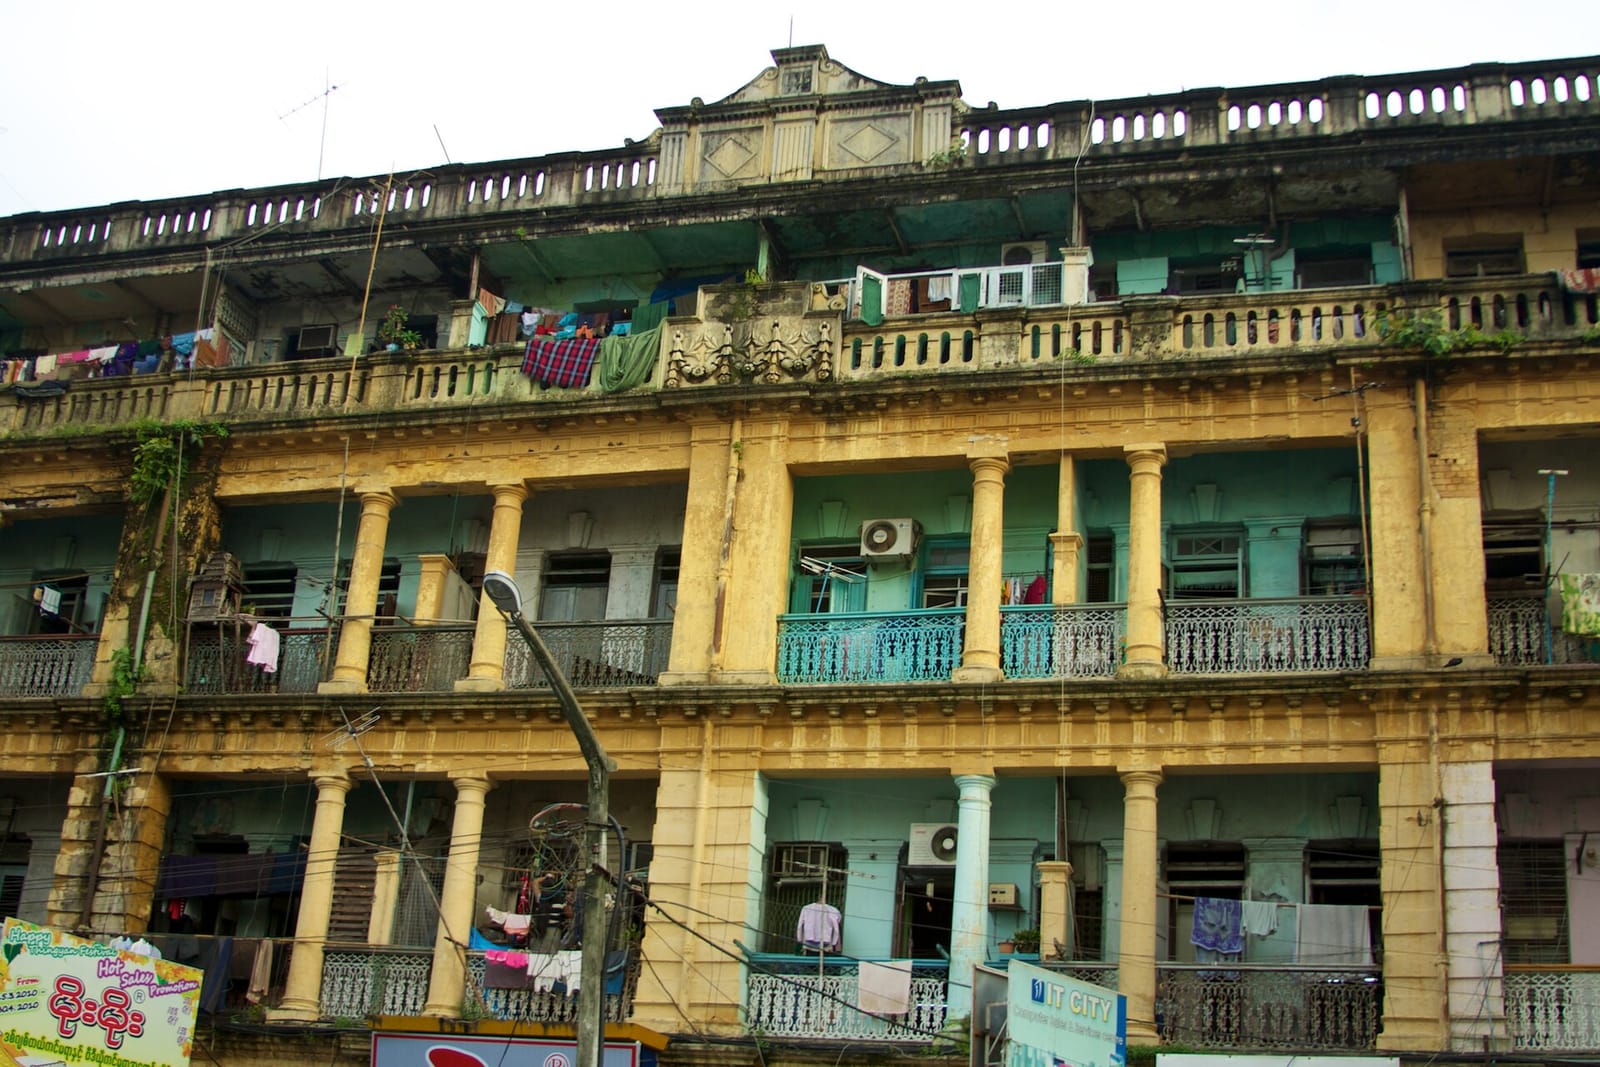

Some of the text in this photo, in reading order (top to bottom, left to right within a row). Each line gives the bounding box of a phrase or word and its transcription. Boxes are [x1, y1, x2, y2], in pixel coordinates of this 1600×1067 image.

[9, 927, 50, 946] Happy
[79, 944, 116, 957] Festival
[98, 958, 124, 978] Hot
[149, 979, 199, 997] Promotion
[1047, 981, 1111, 1022] IT CITY
